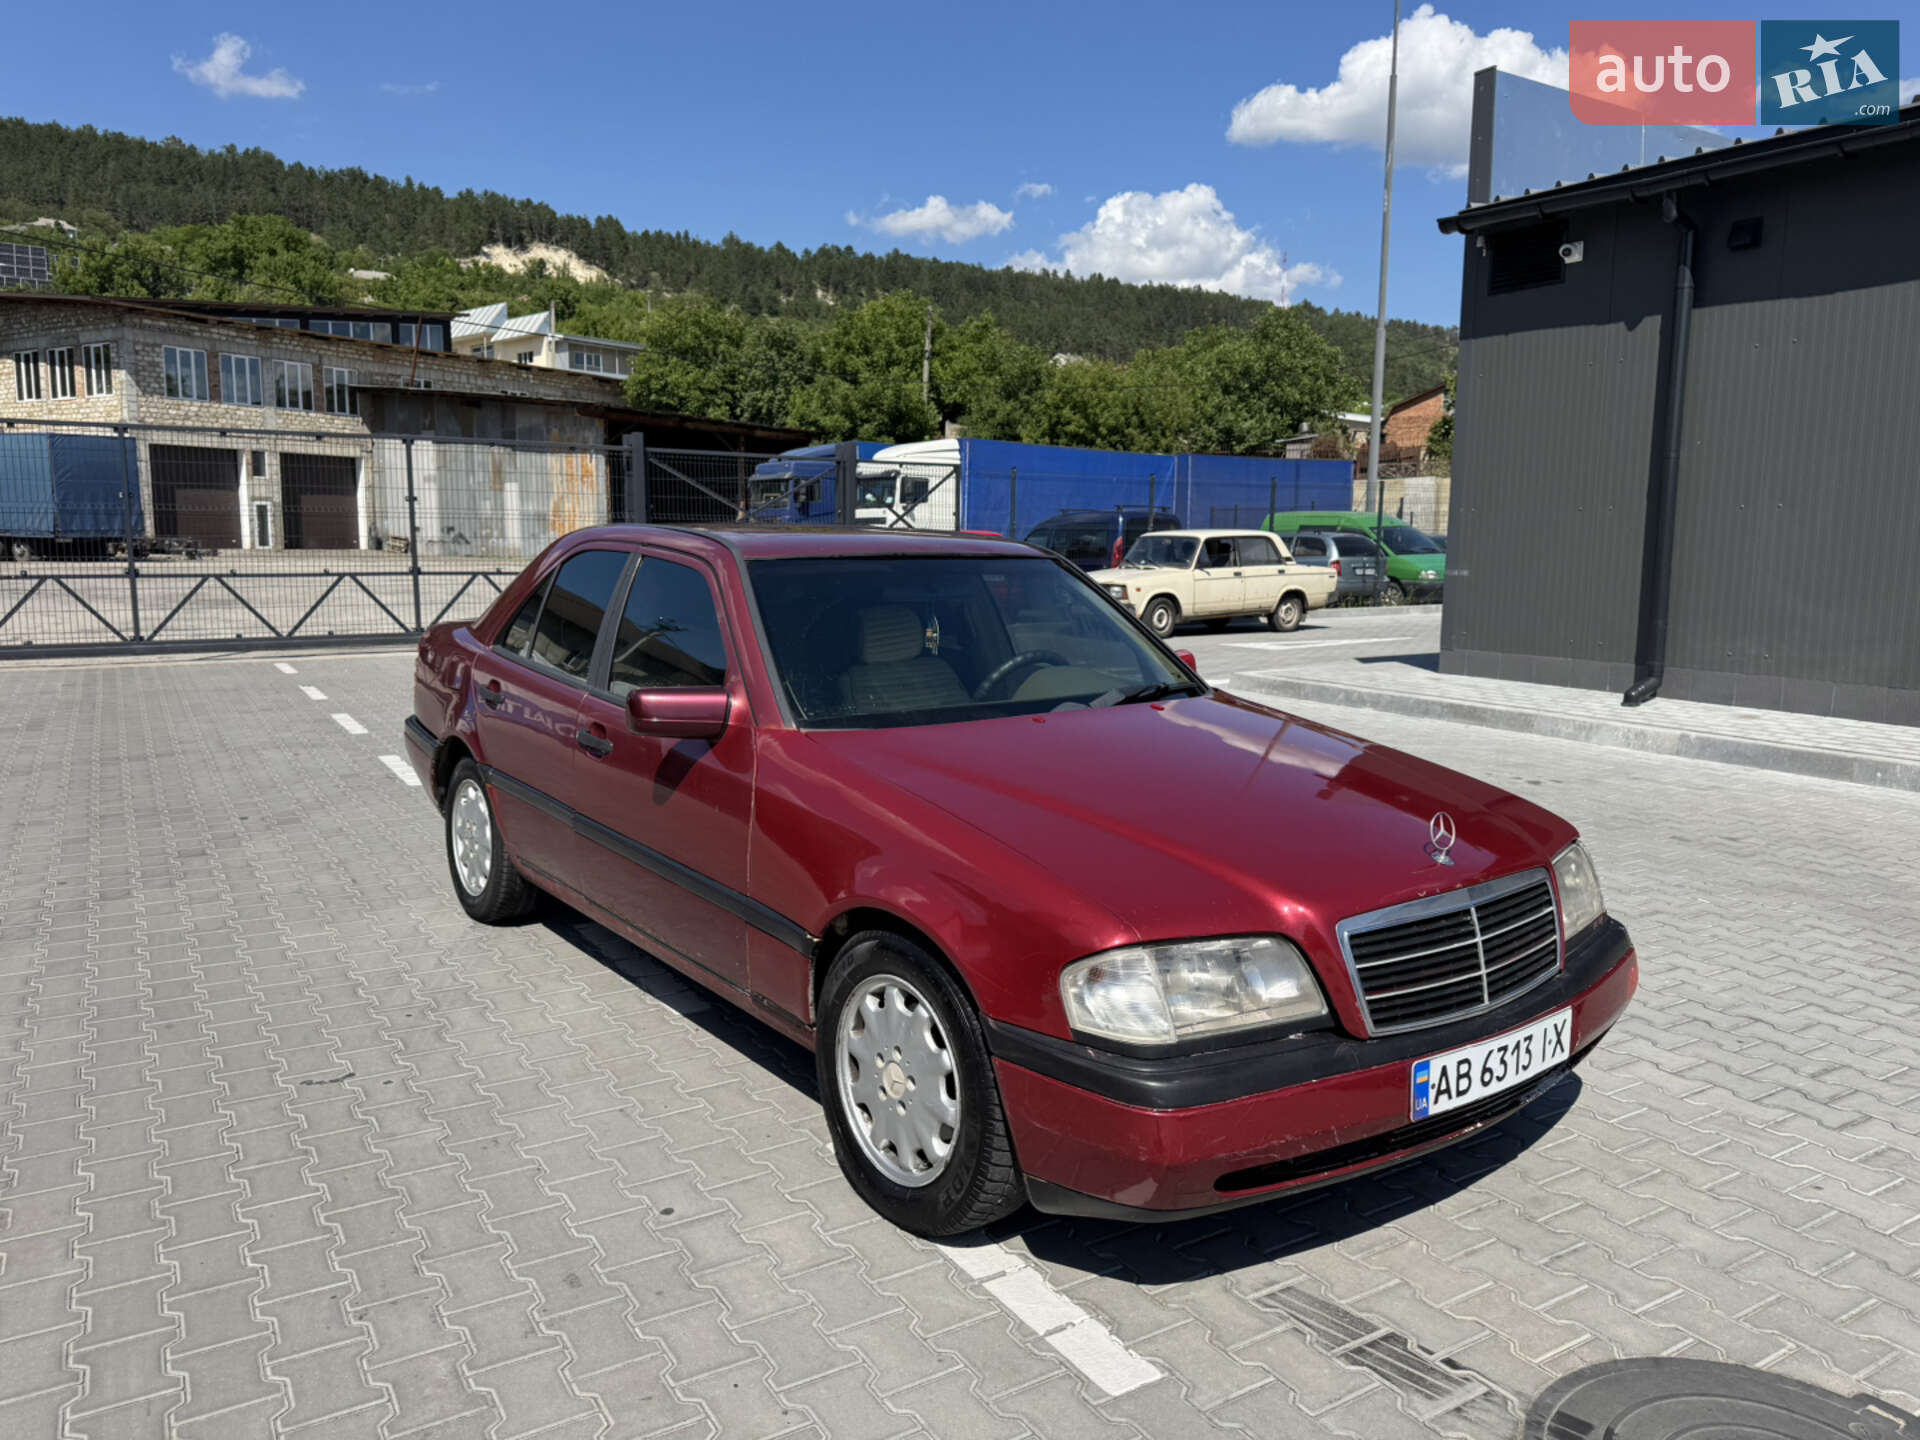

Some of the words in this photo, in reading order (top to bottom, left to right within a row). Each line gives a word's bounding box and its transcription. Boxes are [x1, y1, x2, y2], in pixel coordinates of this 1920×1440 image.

[1433, 1058, 1472, 1105] AB
[1480, 1034, 1533, 1088] 6313
[1542, 1019, 1567, 1062] IX
[1415, 1096, 1428, 1111] UA
